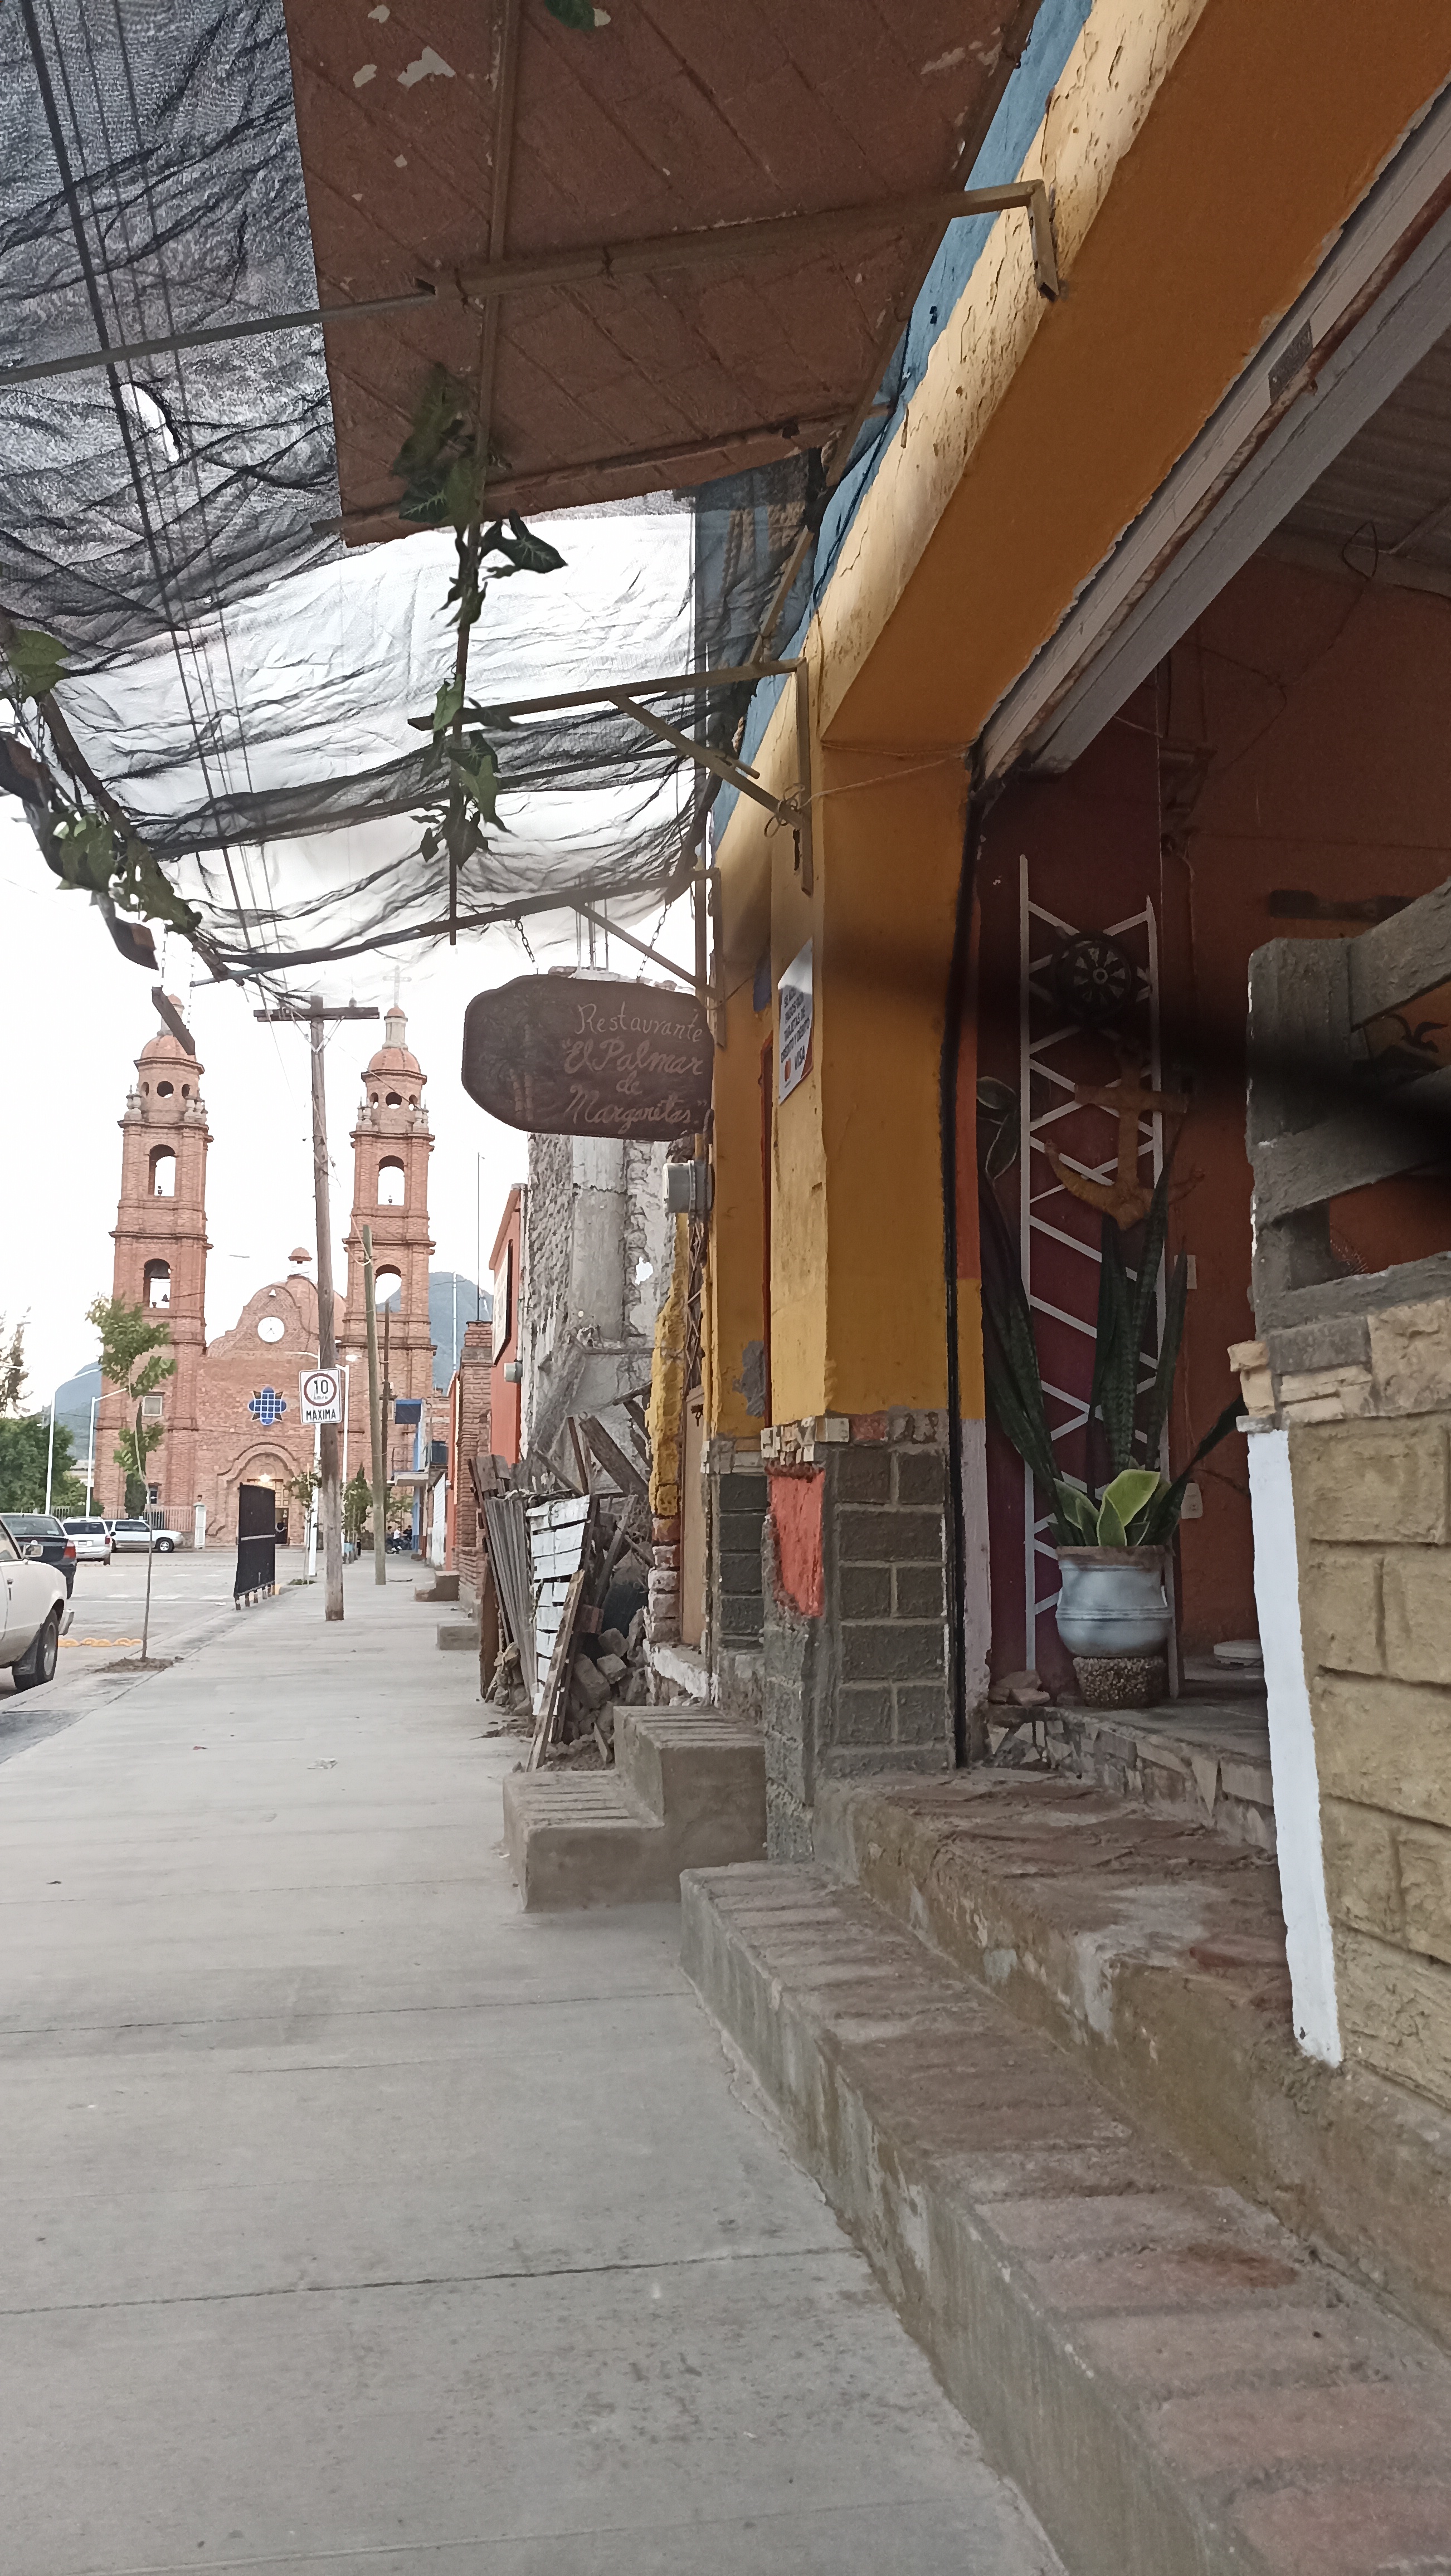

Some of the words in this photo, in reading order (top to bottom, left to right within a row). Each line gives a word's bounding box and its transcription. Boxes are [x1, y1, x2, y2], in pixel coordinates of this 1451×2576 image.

[592, 1036, 703, 1075] Palmar
[795, 1046, 805, 1070] VISA
[616, 1070, 642, 1095] de
[314, 1379, 329, 1394] 10
[306, 1409, 336, 1421] MAXIMA
